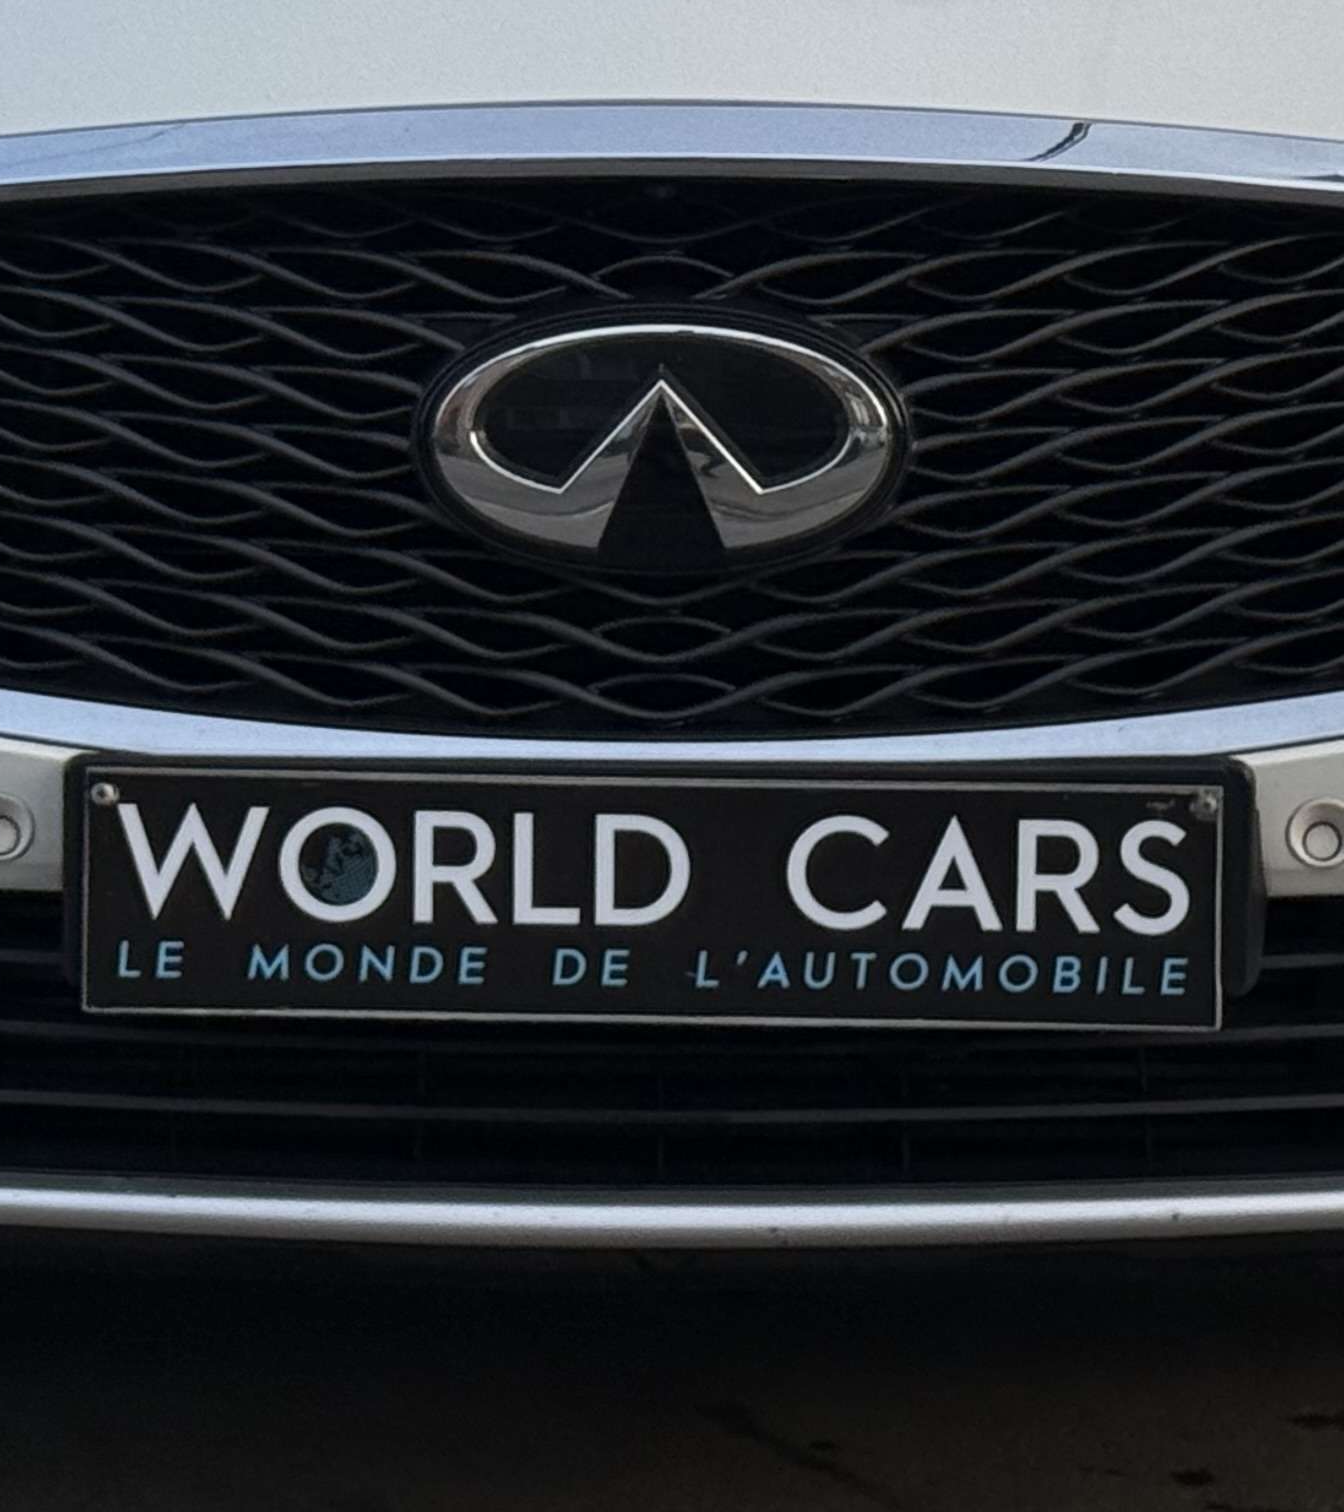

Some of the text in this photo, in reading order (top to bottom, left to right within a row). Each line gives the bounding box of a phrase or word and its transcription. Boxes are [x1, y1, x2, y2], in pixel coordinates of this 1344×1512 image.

[116, 802, 1191, 937] WORLD CARS
[117, 939, 1189, 996] LE MONDE DE L'AUTOMOBILE
